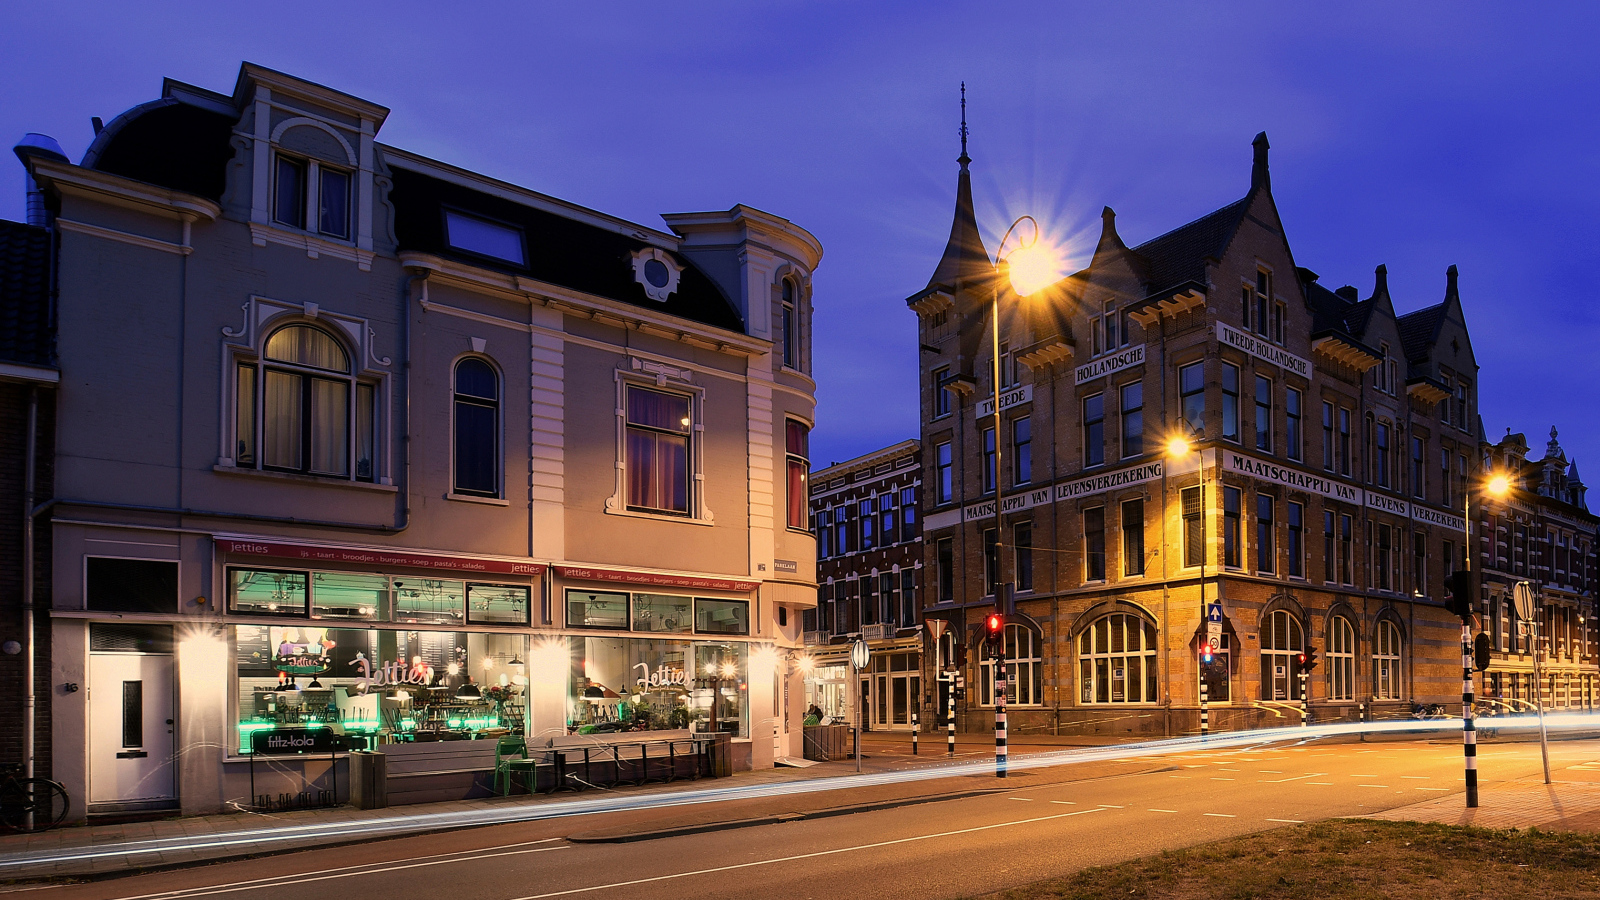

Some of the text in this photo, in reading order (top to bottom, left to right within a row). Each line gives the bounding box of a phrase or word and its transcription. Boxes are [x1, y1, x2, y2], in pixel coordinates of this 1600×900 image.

[1223, 327, 1307, 374] TWEEDE HOLLANDSCHE
[1077, 348, 1143, 381] HOLLANDSCHE
[1057, 463, 1162, 498] LEVENSVERZEKERING
[1233, 455, 1356, 500] MAATSCHAPPIJ VAN
[966, 490, 1047, 520] MAATSCAPPIJ VAN
[1369, 494, 1405, 513] LEVENS
[231, 542, 268, 553] jetties
[300, 550, 309, 558] ijs
[342, 553, 375, 562] broodjes
[379, 555, 408, 565] burgers
[412, 558, 429, 566] soep
[434, 560, 457, 568] pasta's
[461, 562, 485, 570] salades
[511, 563, 540, 573] jetties
[564, 567, 591, 577] jetties
[65, 682, 79, 693] 16
[348, 658, 428, 697] Jetties
[632, 662, 691, 696] Jetties
[267, 734, 315, 748] fritz-kola
